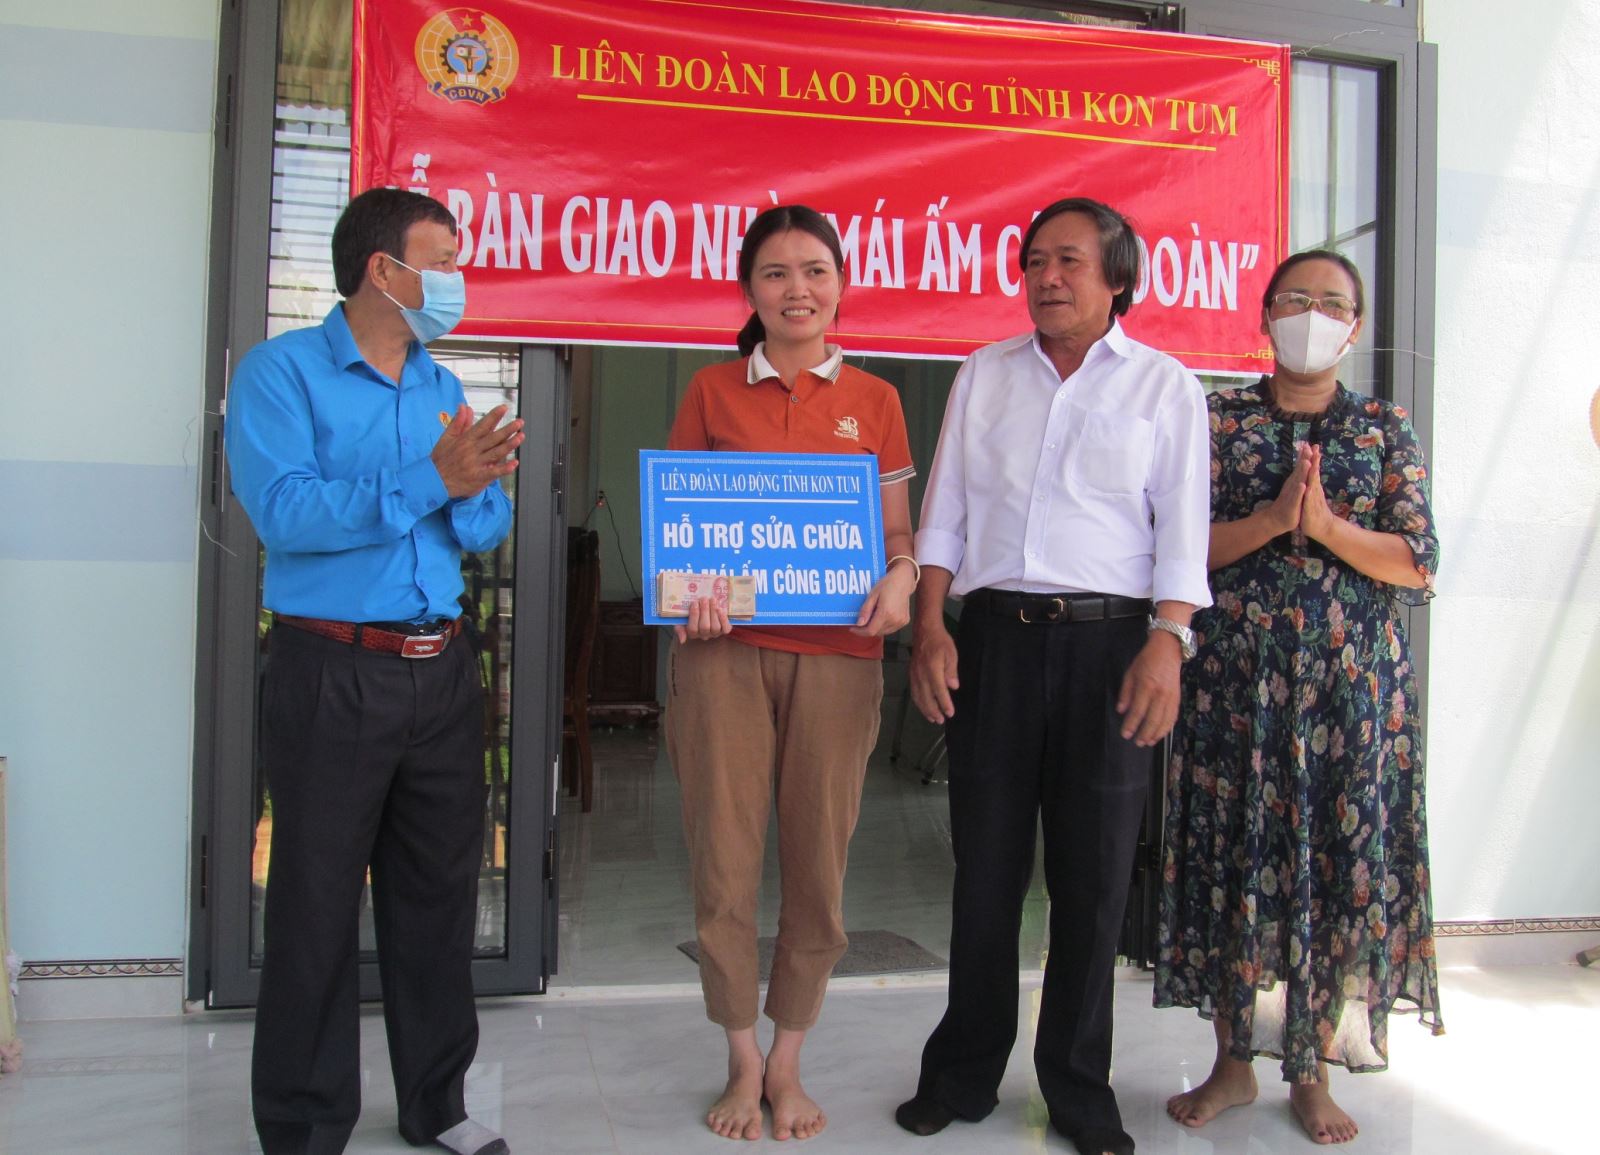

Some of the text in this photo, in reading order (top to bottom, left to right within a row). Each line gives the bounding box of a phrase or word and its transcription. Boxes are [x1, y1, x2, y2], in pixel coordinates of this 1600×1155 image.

[550, 39, 1239, 136] LIÊN ĐOÀN LAO ĐỘNG TỈNH KON TUM
[447, 172, 545, 271] BÀN
[560, 195, 677, 278] GIAO
[691, 190, 779, 281] NH
[917, 196, 983, 295] ẤM
[661, 466, 687, 491] LIÊN
[689, 467, 721, 492] ĐOÀN
[723, 473, 747, 492] LAO
[748, 471, 780, 497] ĐỘNG
[811, 475, 835, 493] KON
[836, 475, 860, 494] TUM
[663, 513, 864, 554] HỖ TRỢ SỬA CHỮA
[773, 563, 821, 595] CÔNG
[824, 564, 872, 595] ĐOÀN
